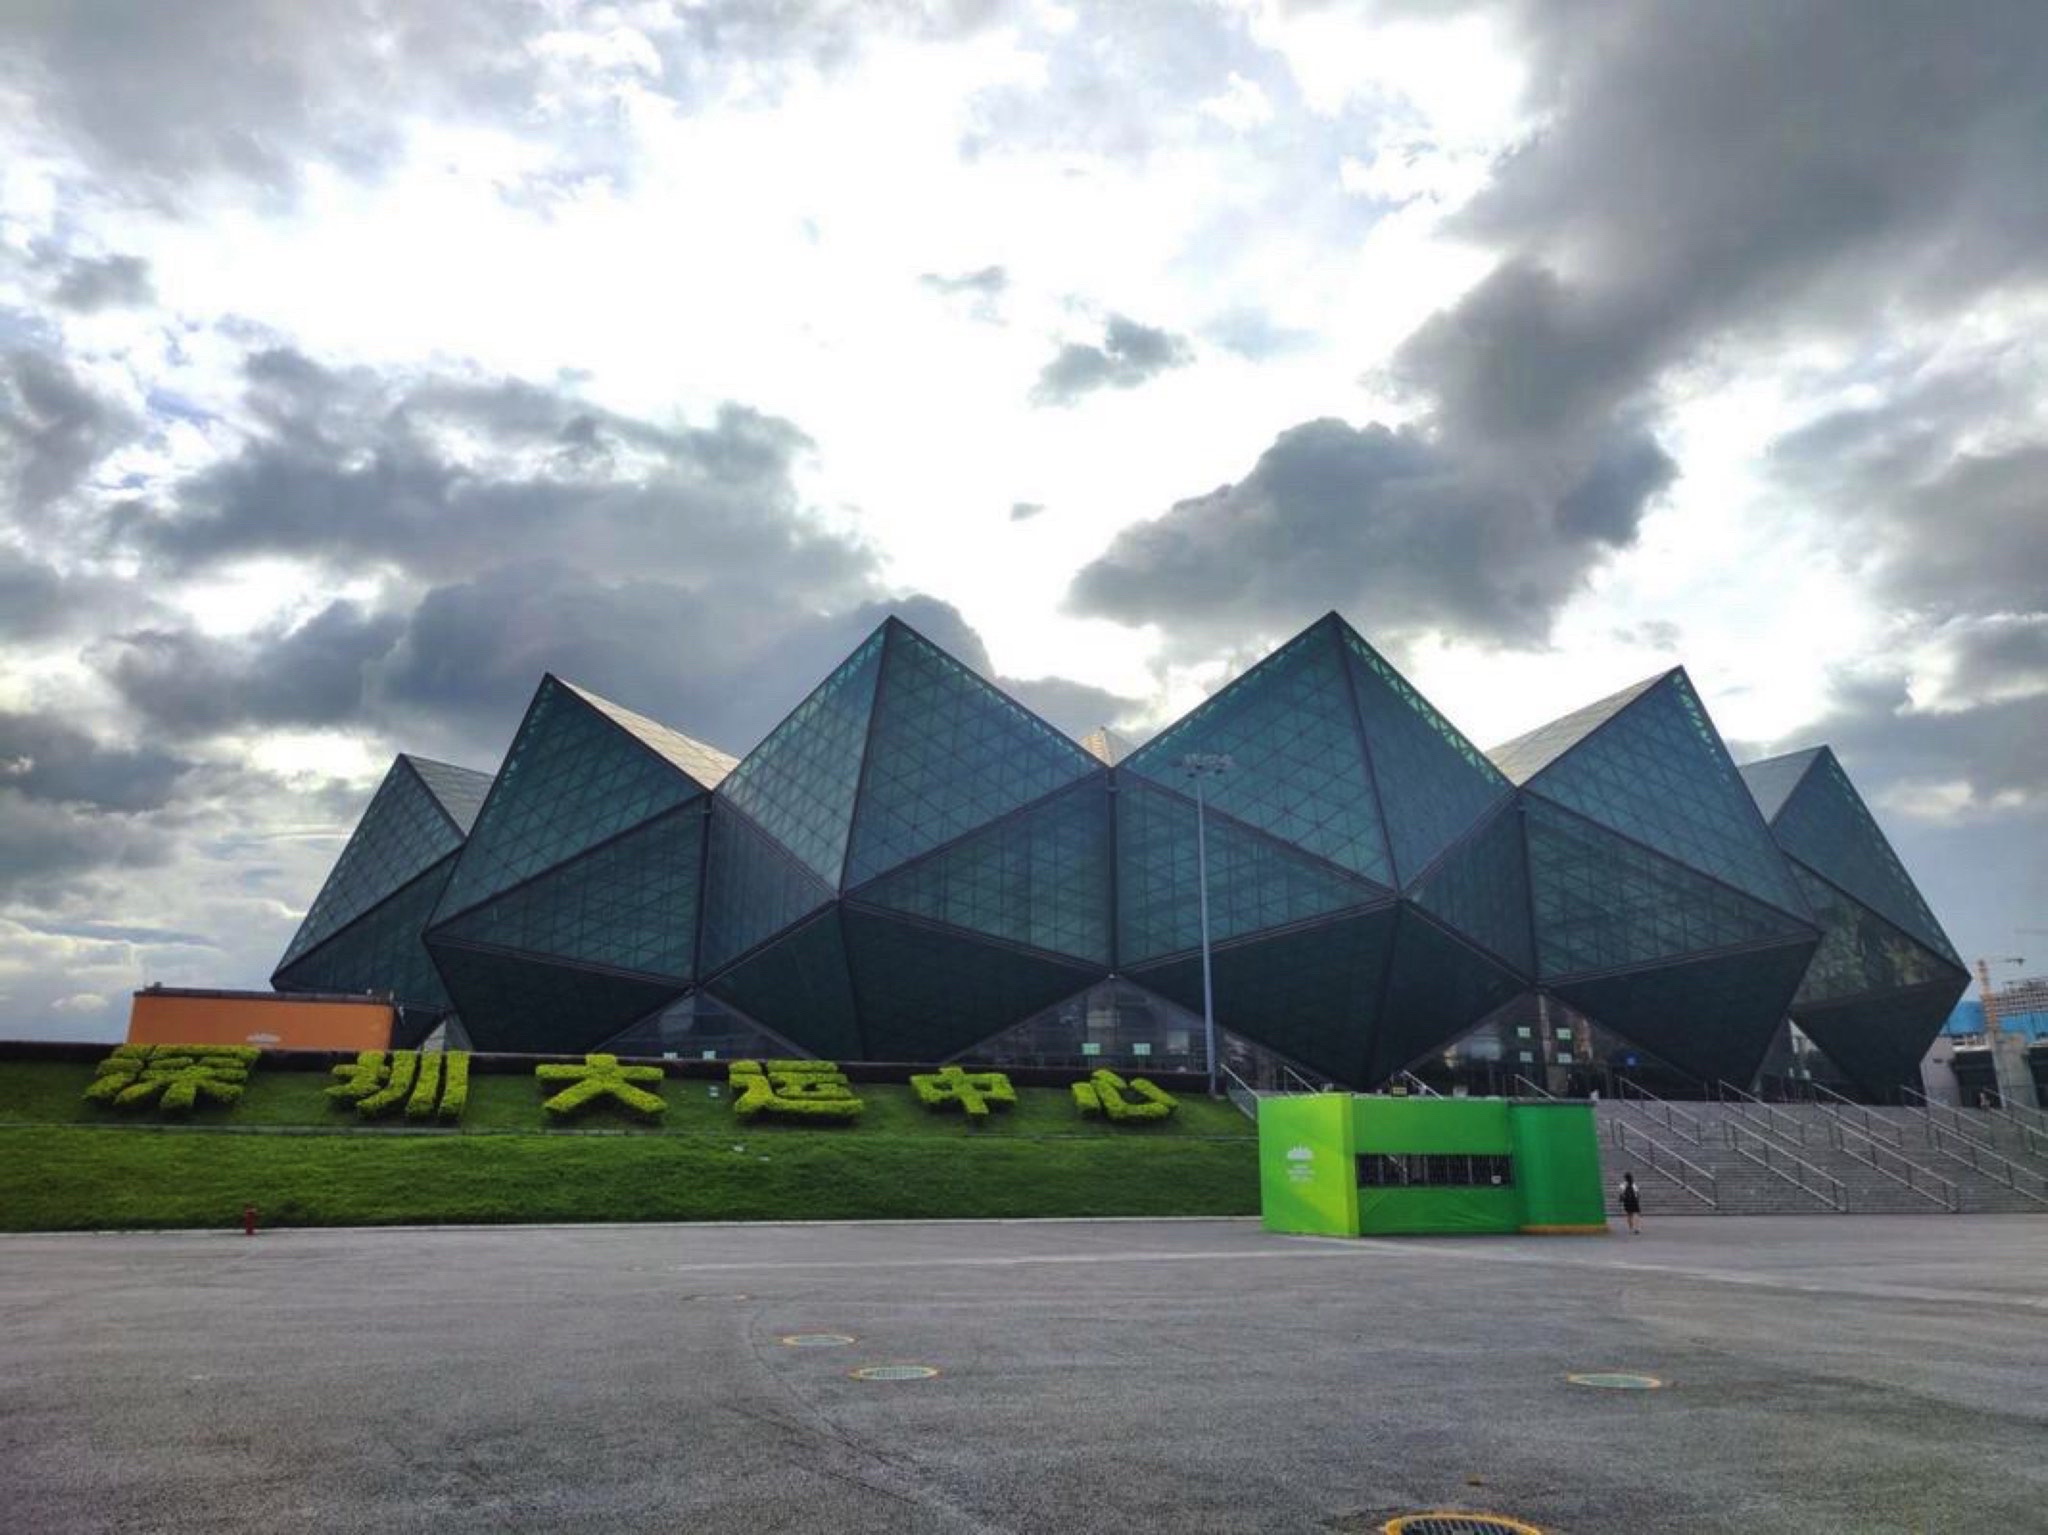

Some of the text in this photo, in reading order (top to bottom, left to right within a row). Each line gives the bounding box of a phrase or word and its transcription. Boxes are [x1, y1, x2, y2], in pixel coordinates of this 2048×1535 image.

[84, 1043, 1179, 1120] 深圳大运中心
